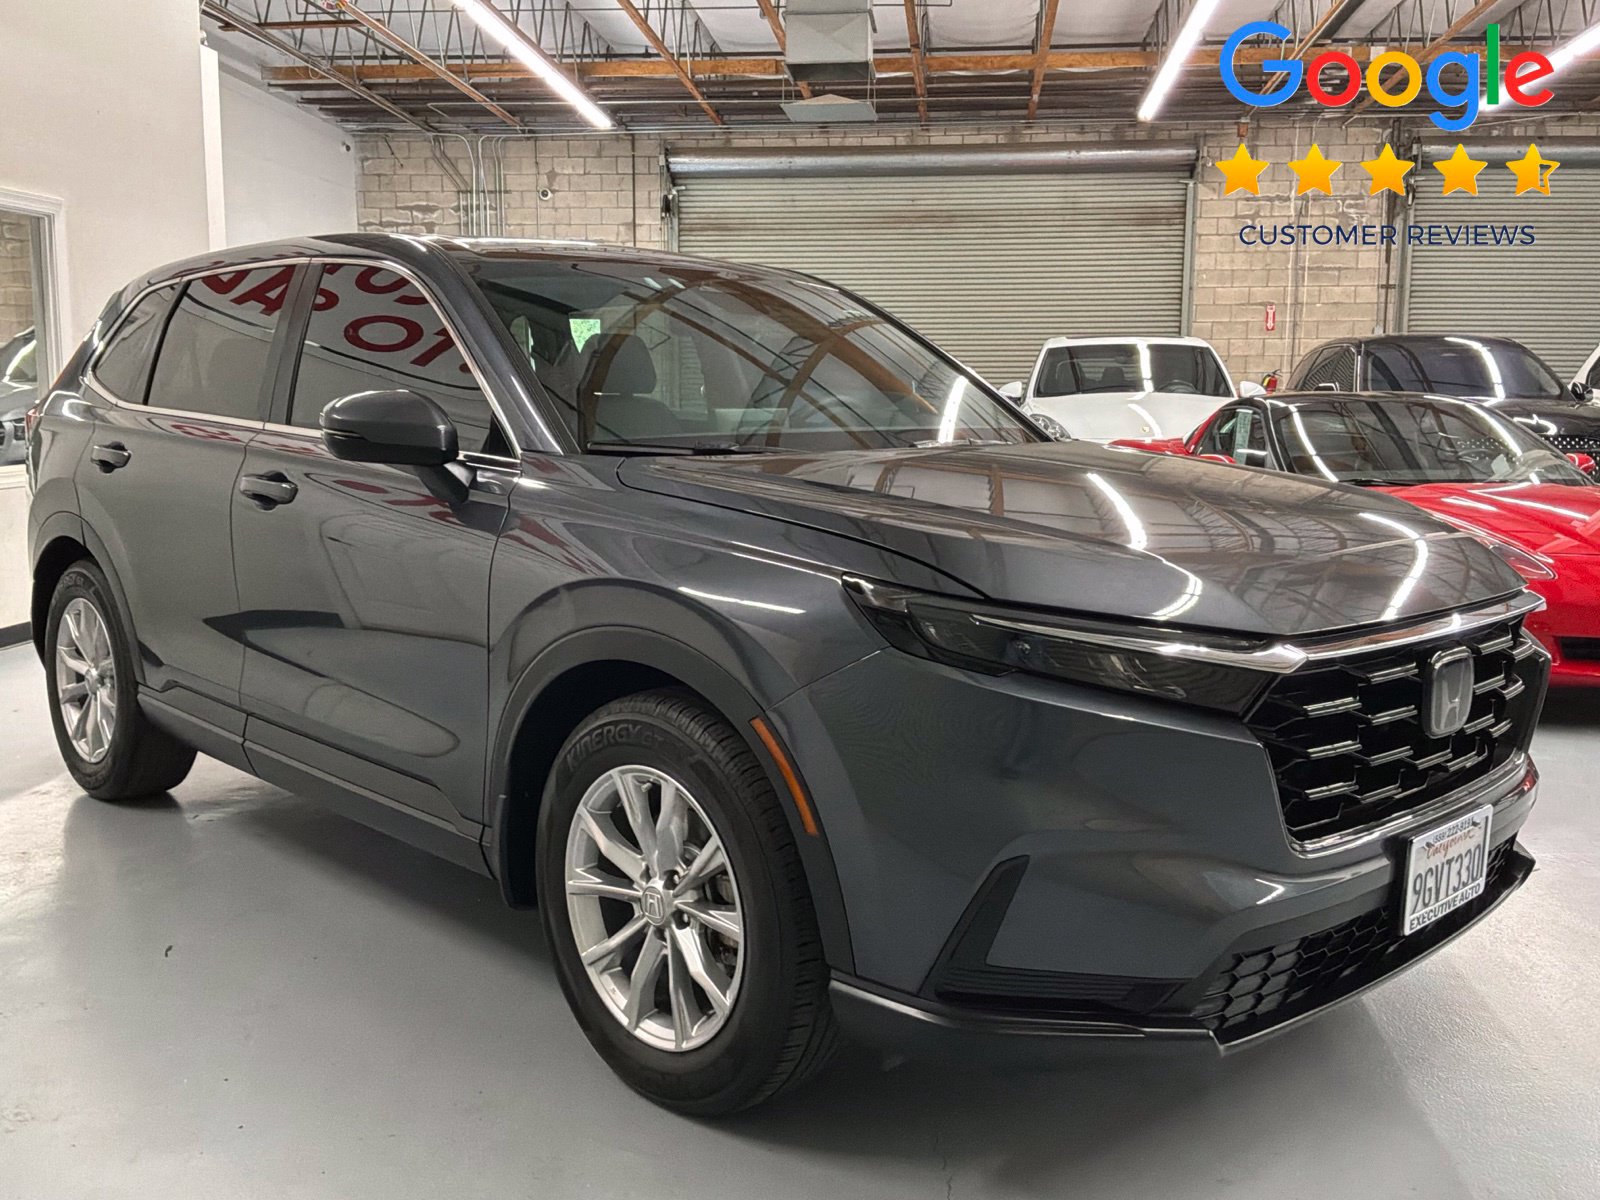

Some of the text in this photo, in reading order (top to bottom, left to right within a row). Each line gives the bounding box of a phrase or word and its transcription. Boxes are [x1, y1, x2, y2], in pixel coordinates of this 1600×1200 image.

[1409, 882, 1481, 932] EXECUTIVE AUTO
[1410, 843, 1483, 916] 9GVT330
